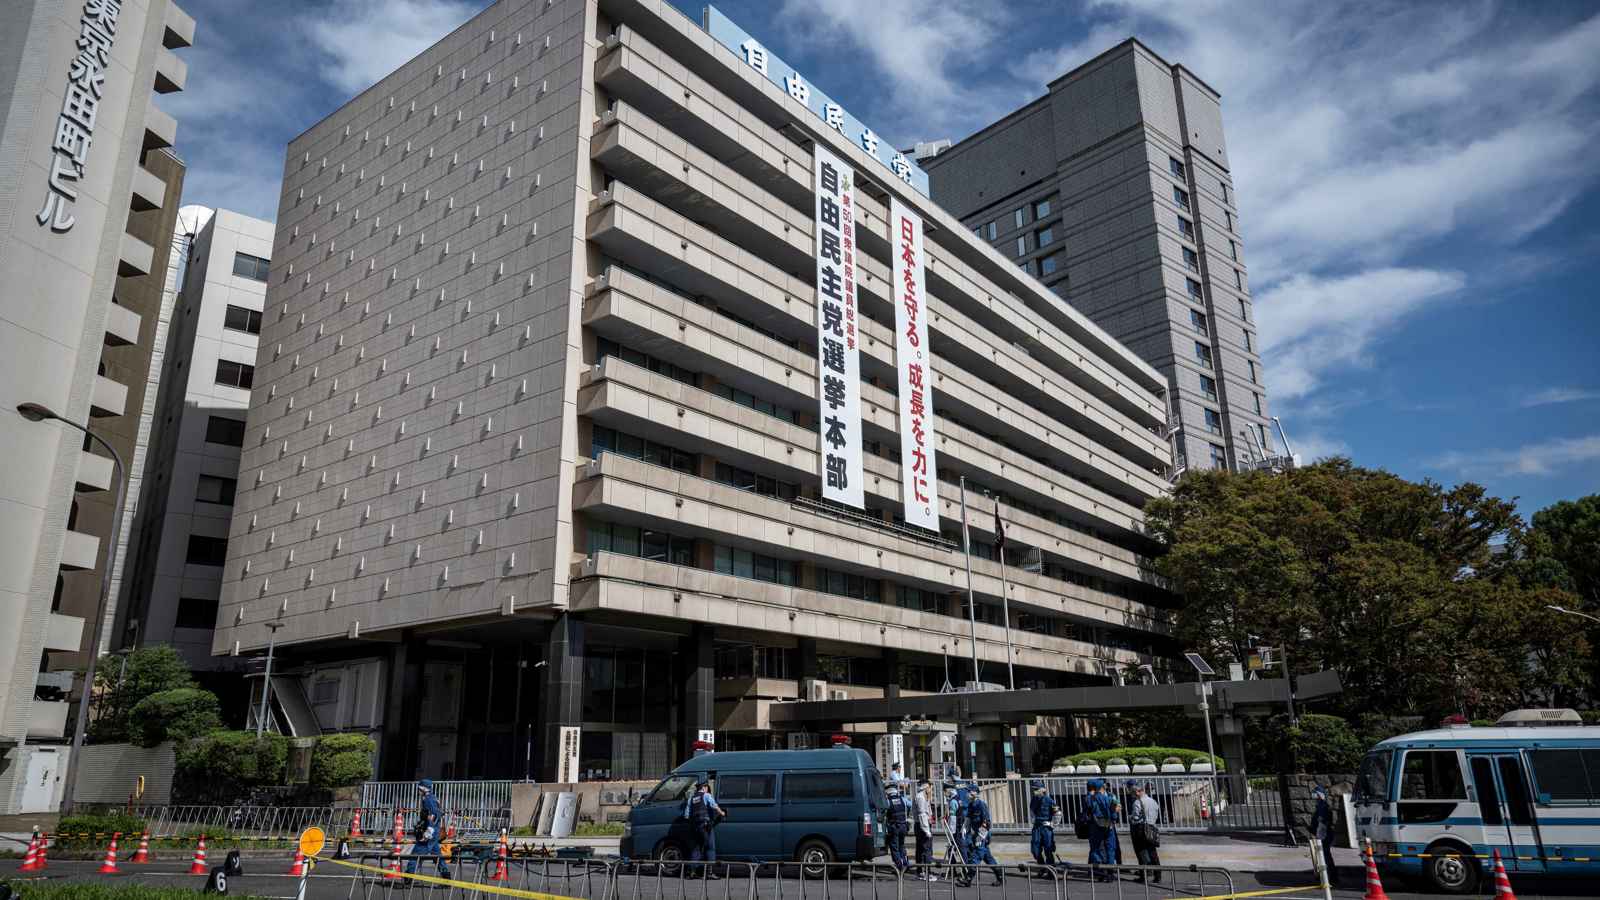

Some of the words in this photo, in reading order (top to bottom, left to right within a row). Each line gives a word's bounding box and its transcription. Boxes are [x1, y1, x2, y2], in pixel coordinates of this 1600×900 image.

[36, 0, 121, 233] 東京永田町ビル
[741, 38, 913, 187] 自由民主党
[820, 161, 848, 491] 自由民主党選挙本部
[842, 194, 856, 350] 第50回衆議院議員総選挙
[901, 215, 931, 517] 日本を守る。成長を力に。
[216, 871, 226, 892] 6
[341, 842, 349, 856] A
